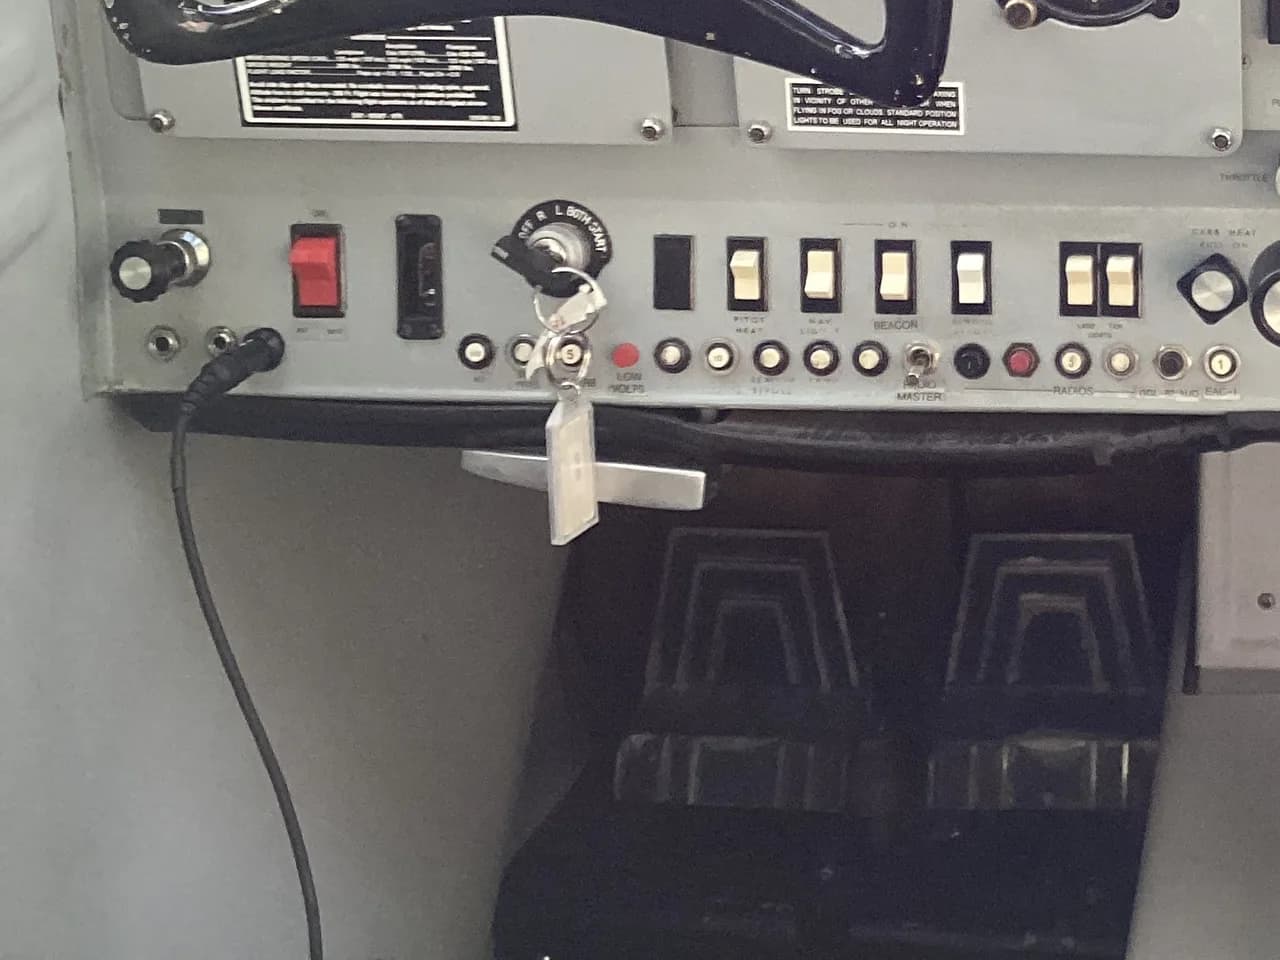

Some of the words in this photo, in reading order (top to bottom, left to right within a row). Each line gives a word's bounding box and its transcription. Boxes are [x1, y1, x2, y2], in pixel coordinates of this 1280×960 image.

[555, 205, 563, 215] L
[536, 211, 547, 221] R
[566, 206, 591, 225] BOTH
[518, 220, 533, 239] OFF
[588, 222, 607, 253] START
[873, 320, 918, 330] BEACON
[896, 392, 942, 401] MASTER
